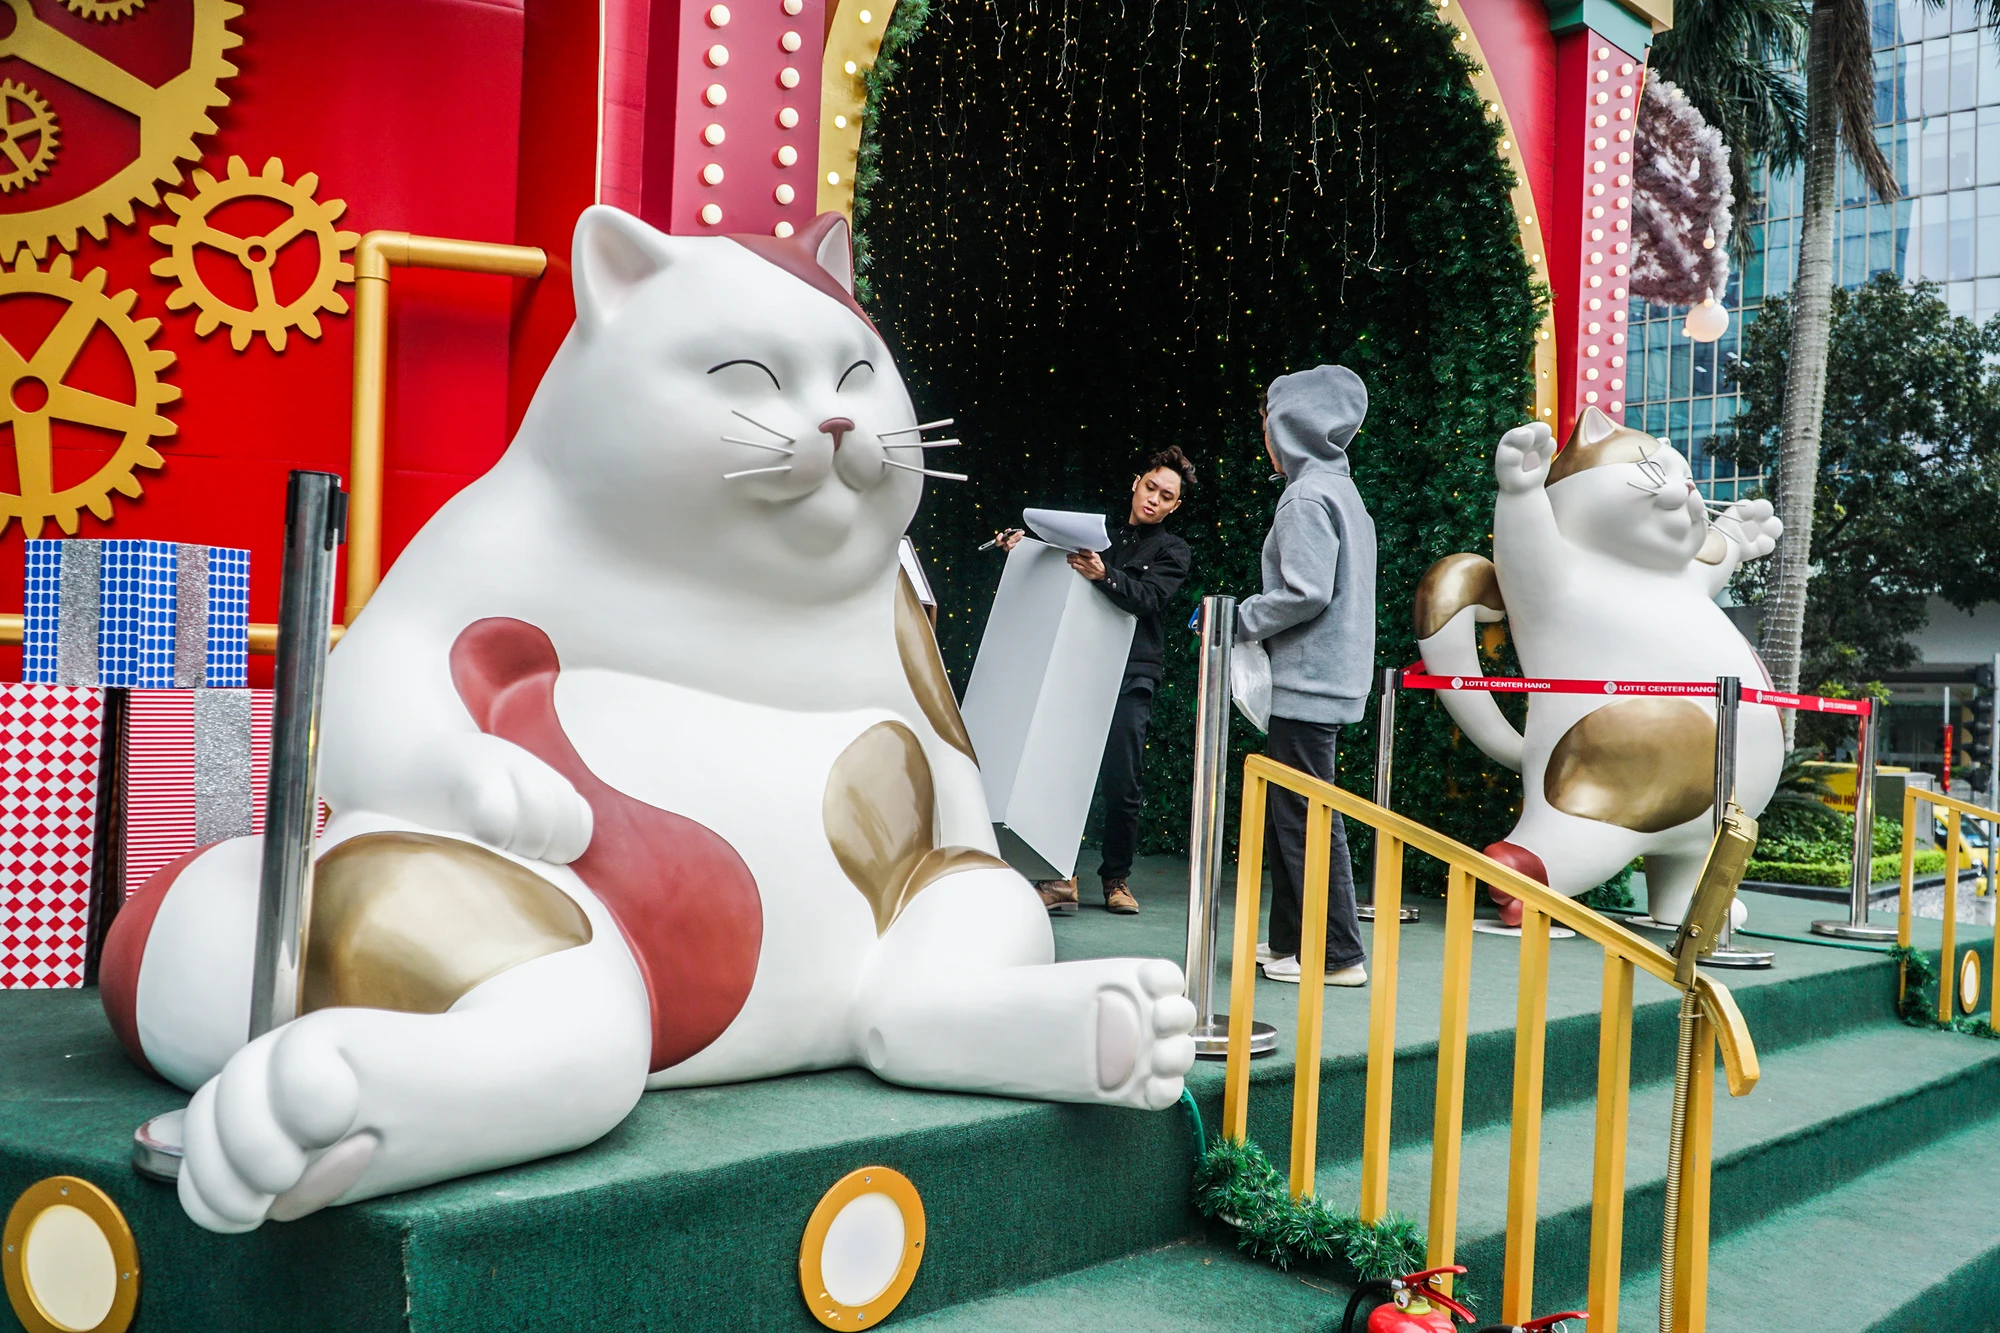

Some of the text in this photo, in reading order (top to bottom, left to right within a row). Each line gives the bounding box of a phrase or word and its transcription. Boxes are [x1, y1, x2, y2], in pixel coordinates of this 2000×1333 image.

[1465, 680, 1488, 688] LOTTE
[1490, 681, 1523, 689] CENTER
[1619, 684, 1646, 692] LOTTE
